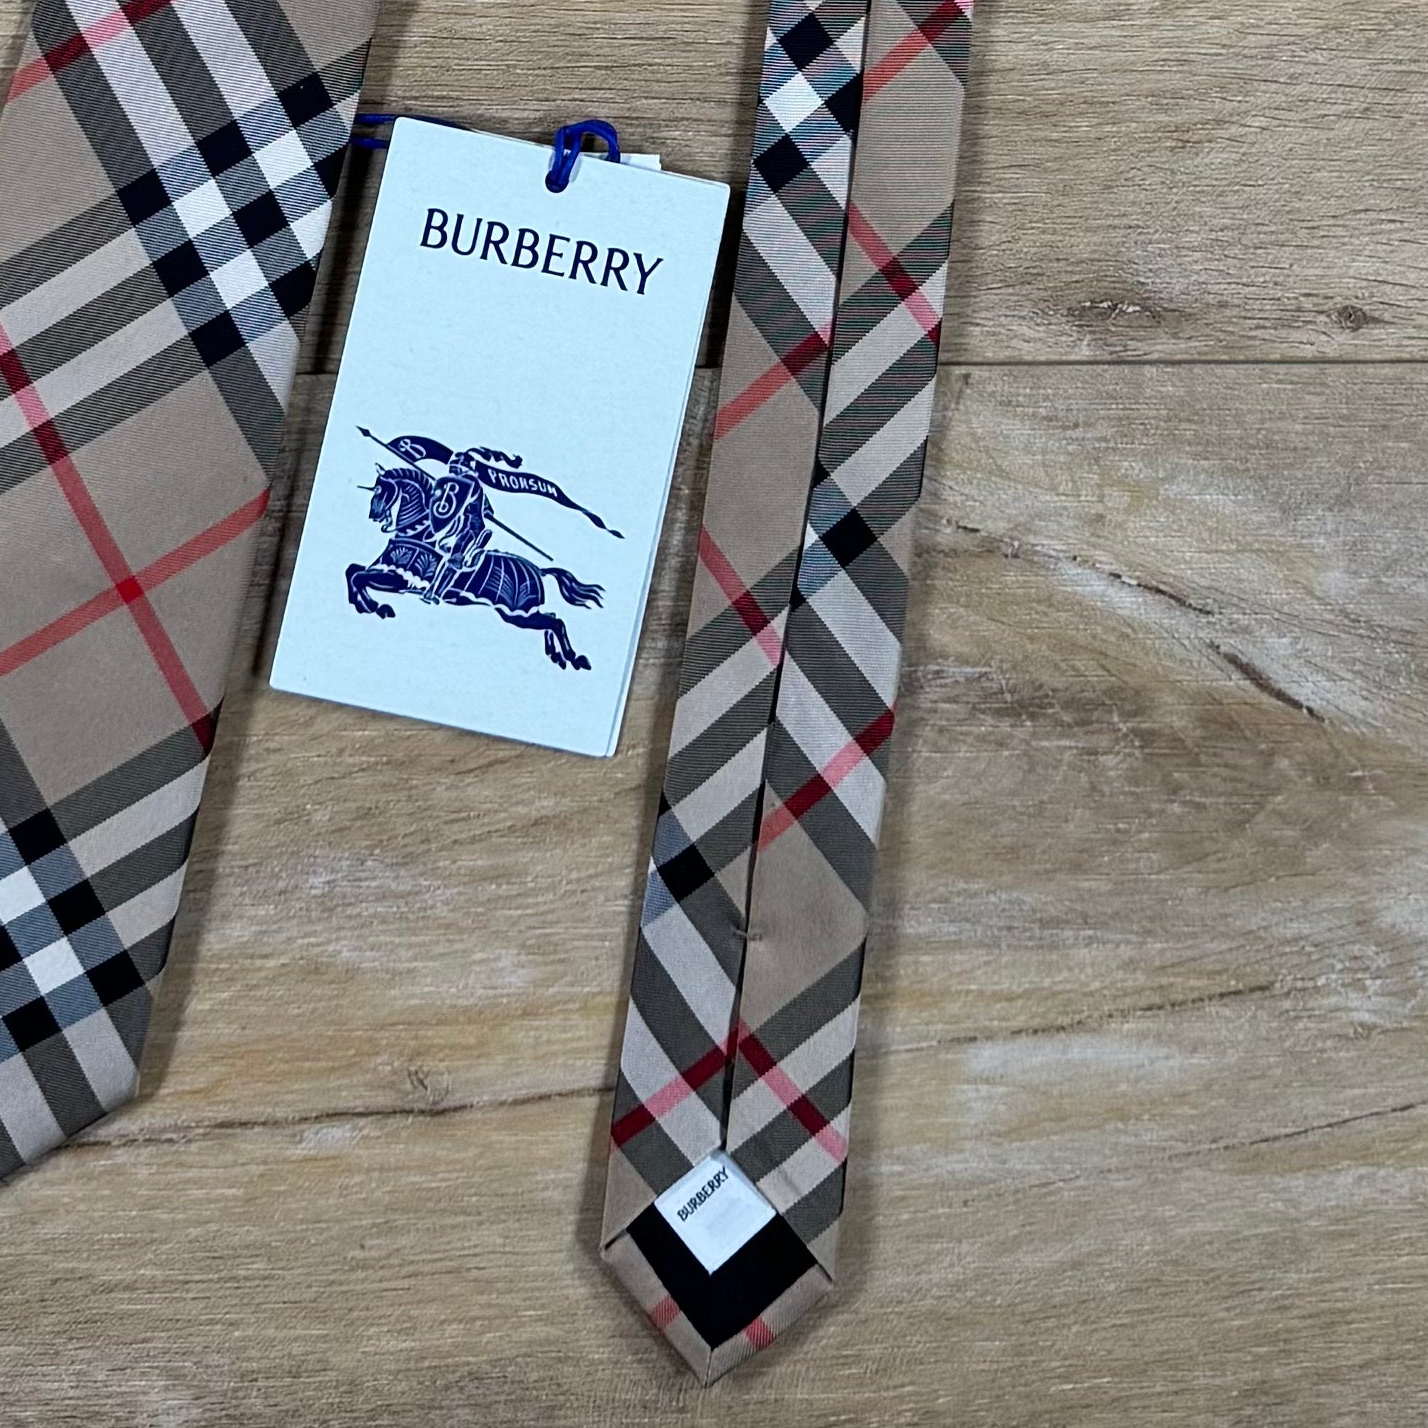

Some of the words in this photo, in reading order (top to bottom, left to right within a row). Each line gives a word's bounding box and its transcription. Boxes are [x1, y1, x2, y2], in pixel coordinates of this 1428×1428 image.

[420, 208, 664, 295] BURBERRY
[432, 481, 460, 517] B
[677, 1164, 729, 1222] BURBERRY
